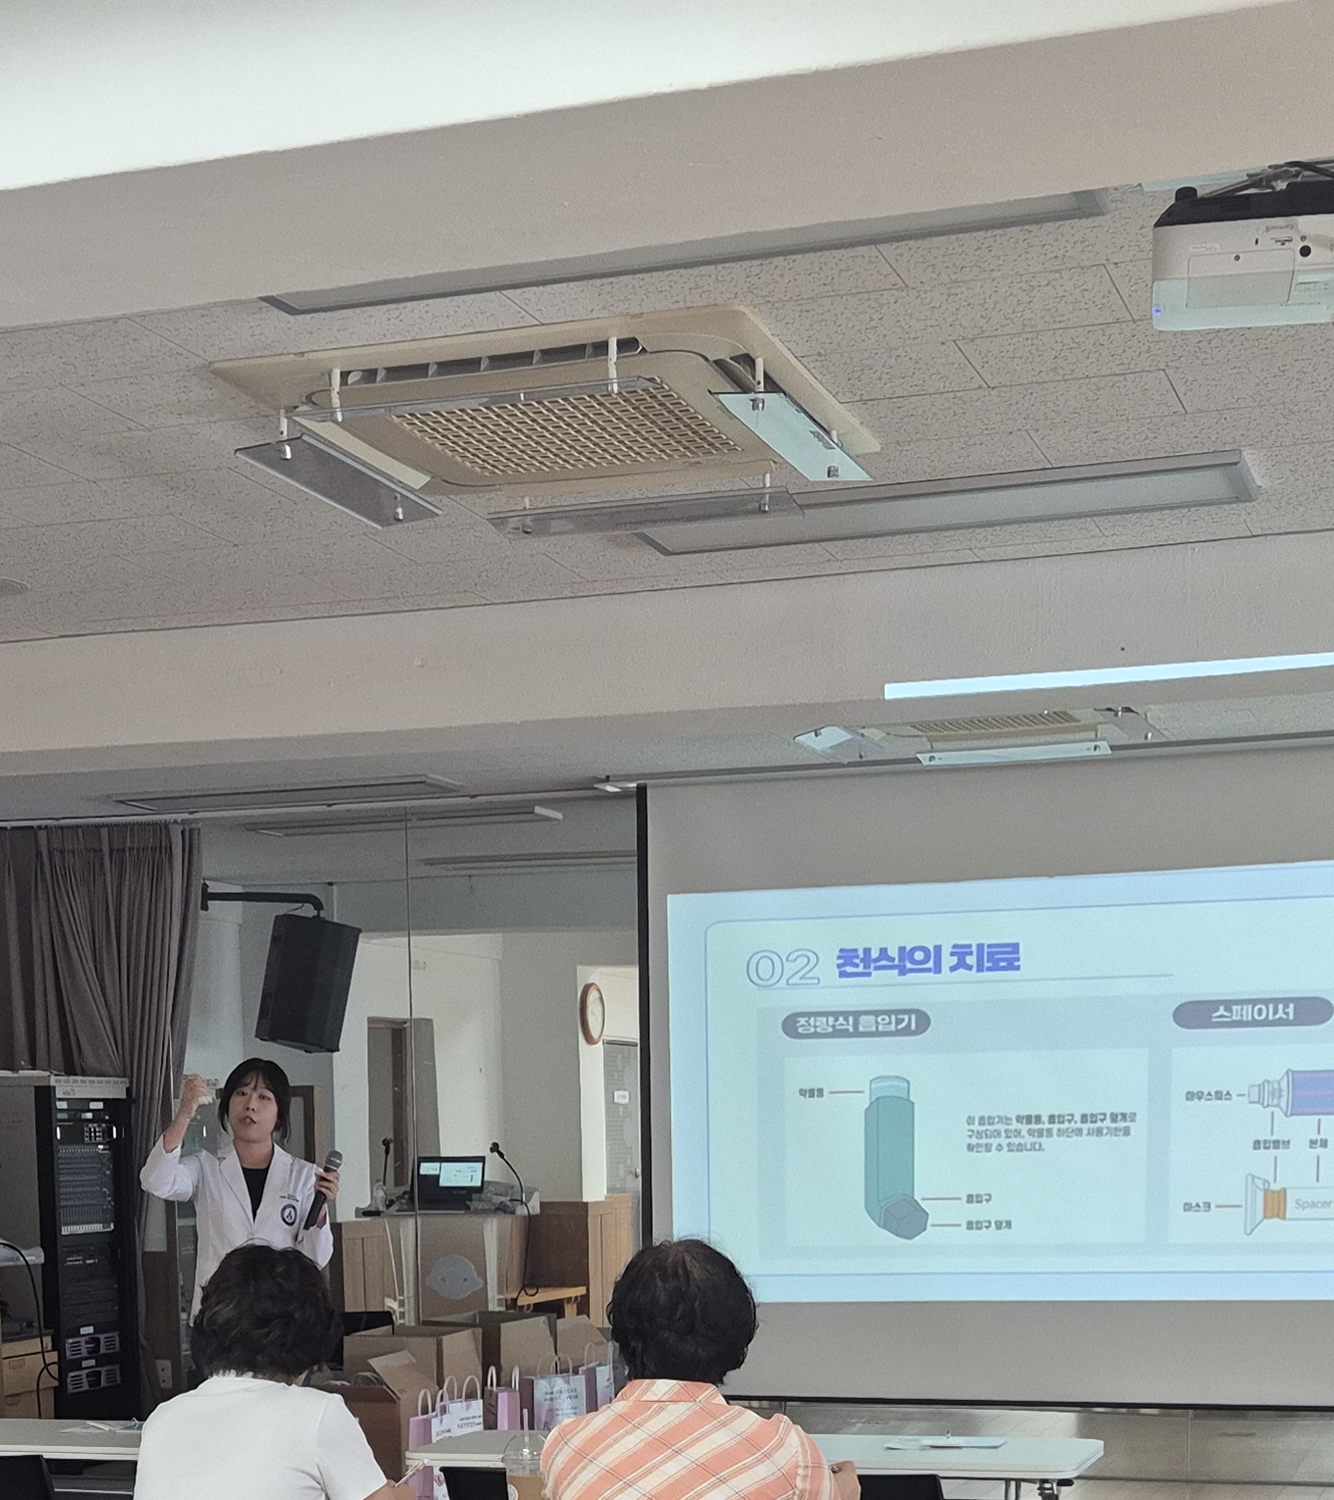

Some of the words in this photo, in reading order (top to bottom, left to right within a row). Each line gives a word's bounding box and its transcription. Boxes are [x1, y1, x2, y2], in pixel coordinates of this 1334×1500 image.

[746, 949, 821, 987] 02
[836, 946, 942, 979] 천식의
[949, 942, 1021, 973] 치료
[1211, 1003, 1295, 1023] 스페이서
[796, 1015, 854, 1034] 정량식
[859, 1014, 916, 1032] 흡입기
[966, 1115, 975, 1126] 이
[996, 1142, 1004, 1152] 수
[1007, 1141, 1045, 1153] 있습니다.
[1183, 1202, 1211, 1212] 마스크
[1295, 1199, 1333, 1211] Spacer
